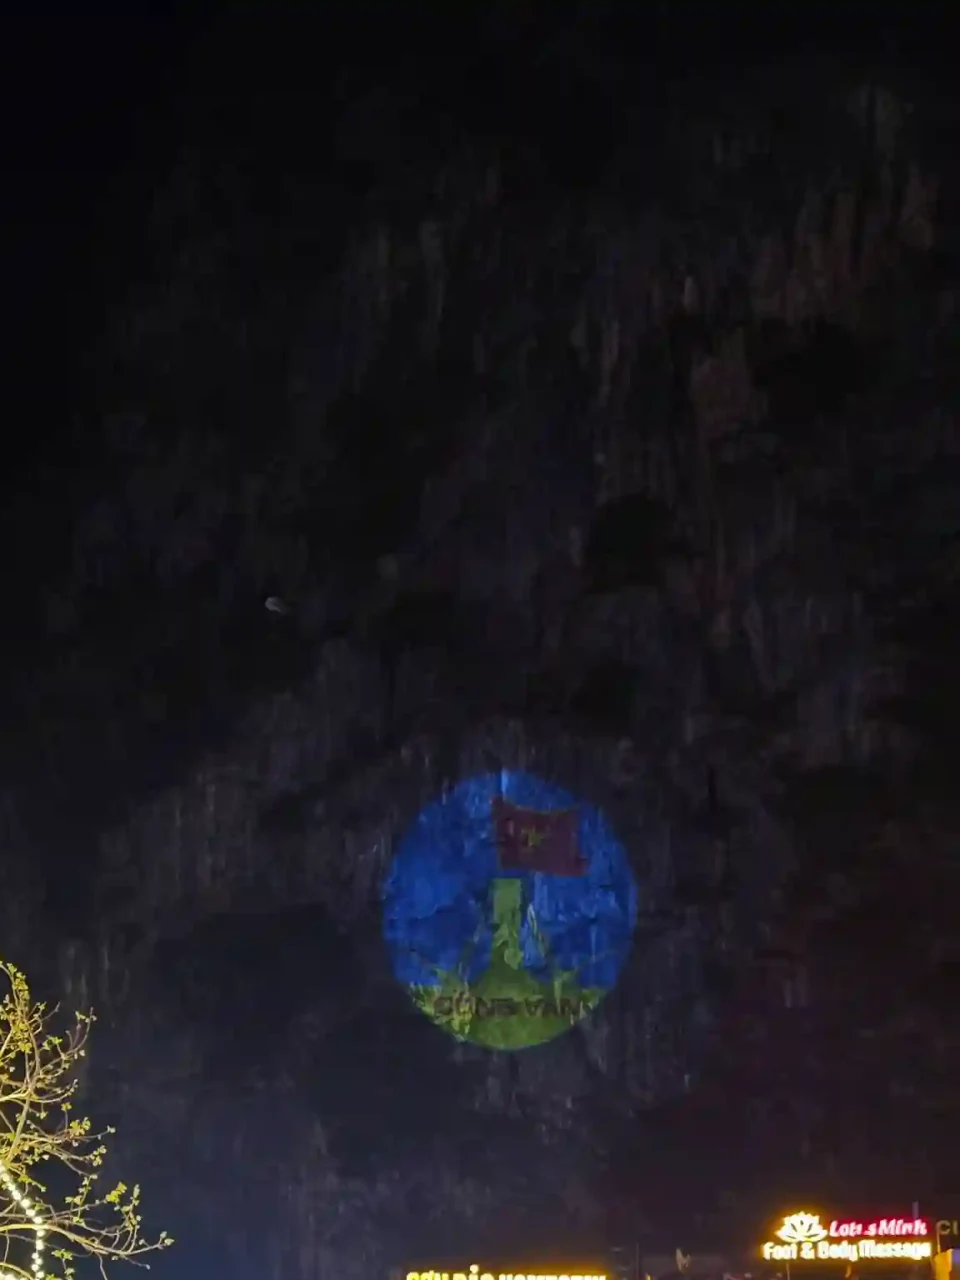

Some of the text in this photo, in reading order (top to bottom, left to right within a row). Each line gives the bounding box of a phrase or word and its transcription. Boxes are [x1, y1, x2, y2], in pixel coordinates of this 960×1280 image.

[762, 1241, 798, 1261] Foot
[800, 1241, 815, 1260] &
[817, 1240, 859, 1262] Body
